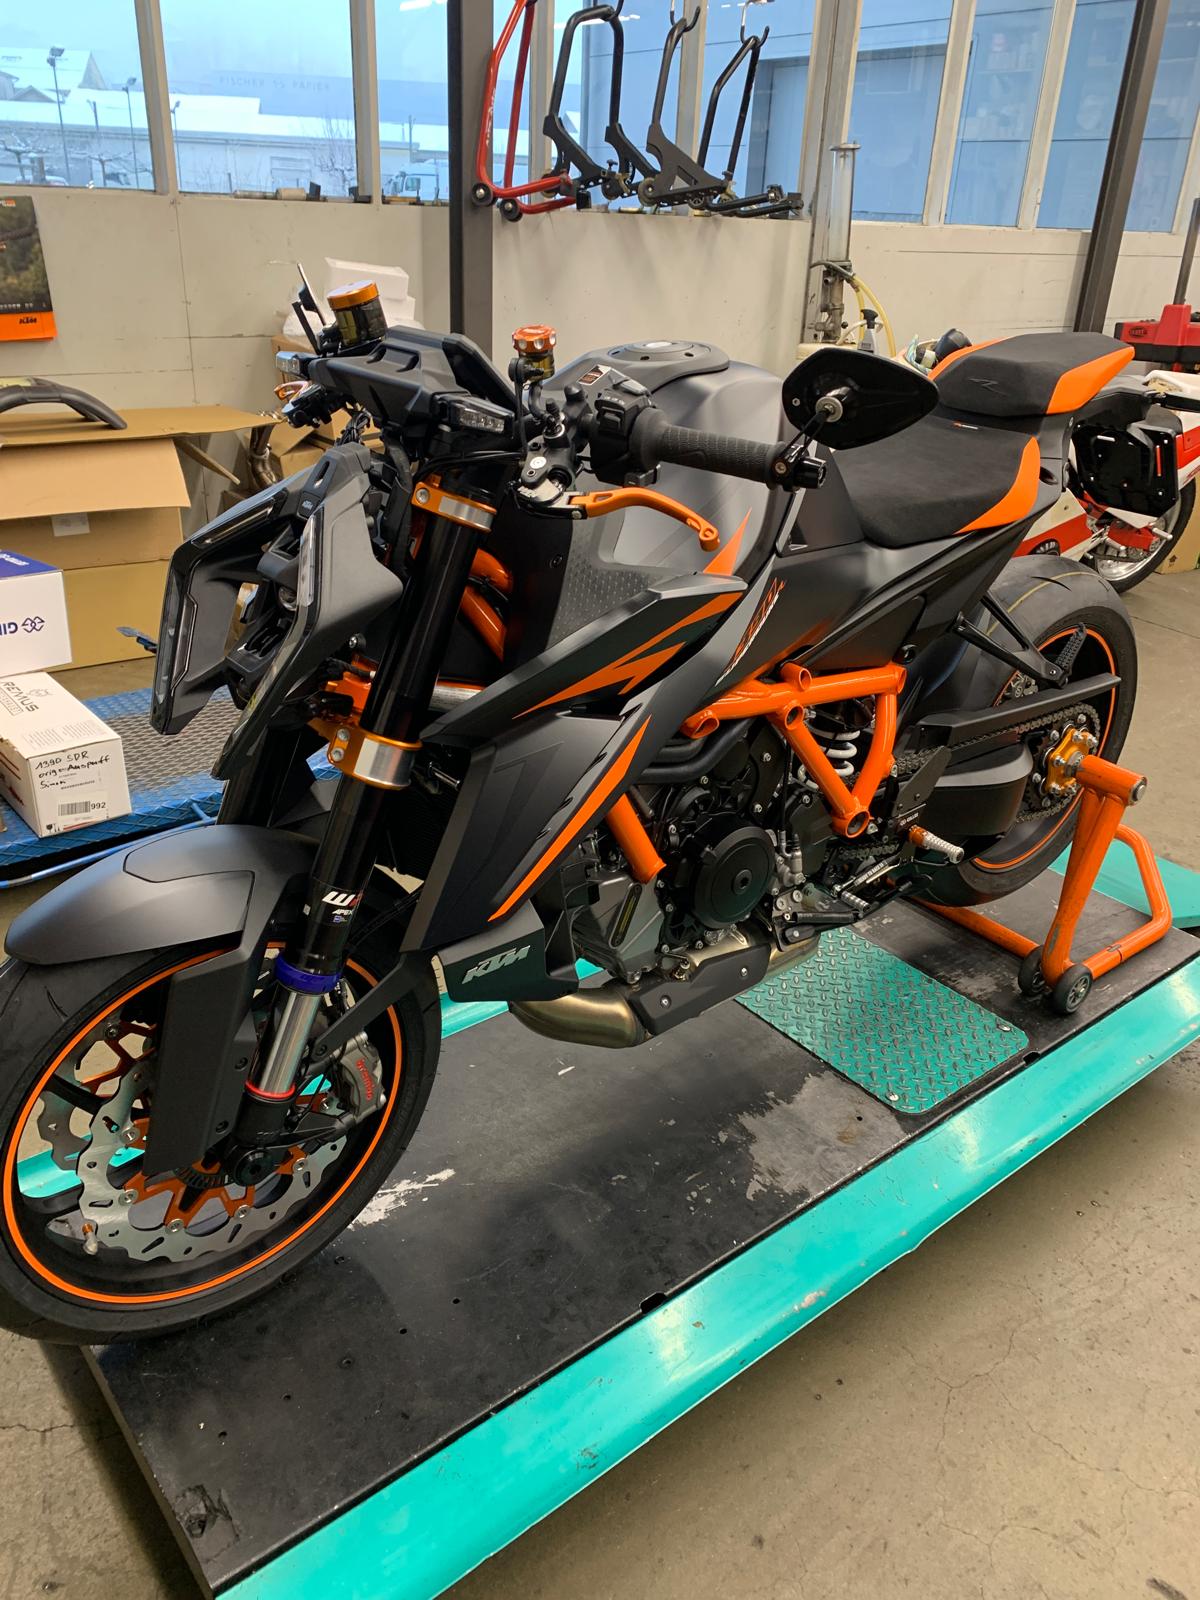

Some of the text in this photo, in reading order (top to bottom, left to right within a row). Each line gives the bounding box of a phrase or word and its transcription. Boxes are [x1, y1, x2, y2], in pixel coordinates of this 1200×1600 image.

[0, 621, 18, 636] GI
[1, 681, 40, 712] REMUS
[67, 750, 89, 763] SDR
[91, 801, 106, 810] 992
[461, 944, 531, 985] KTM
